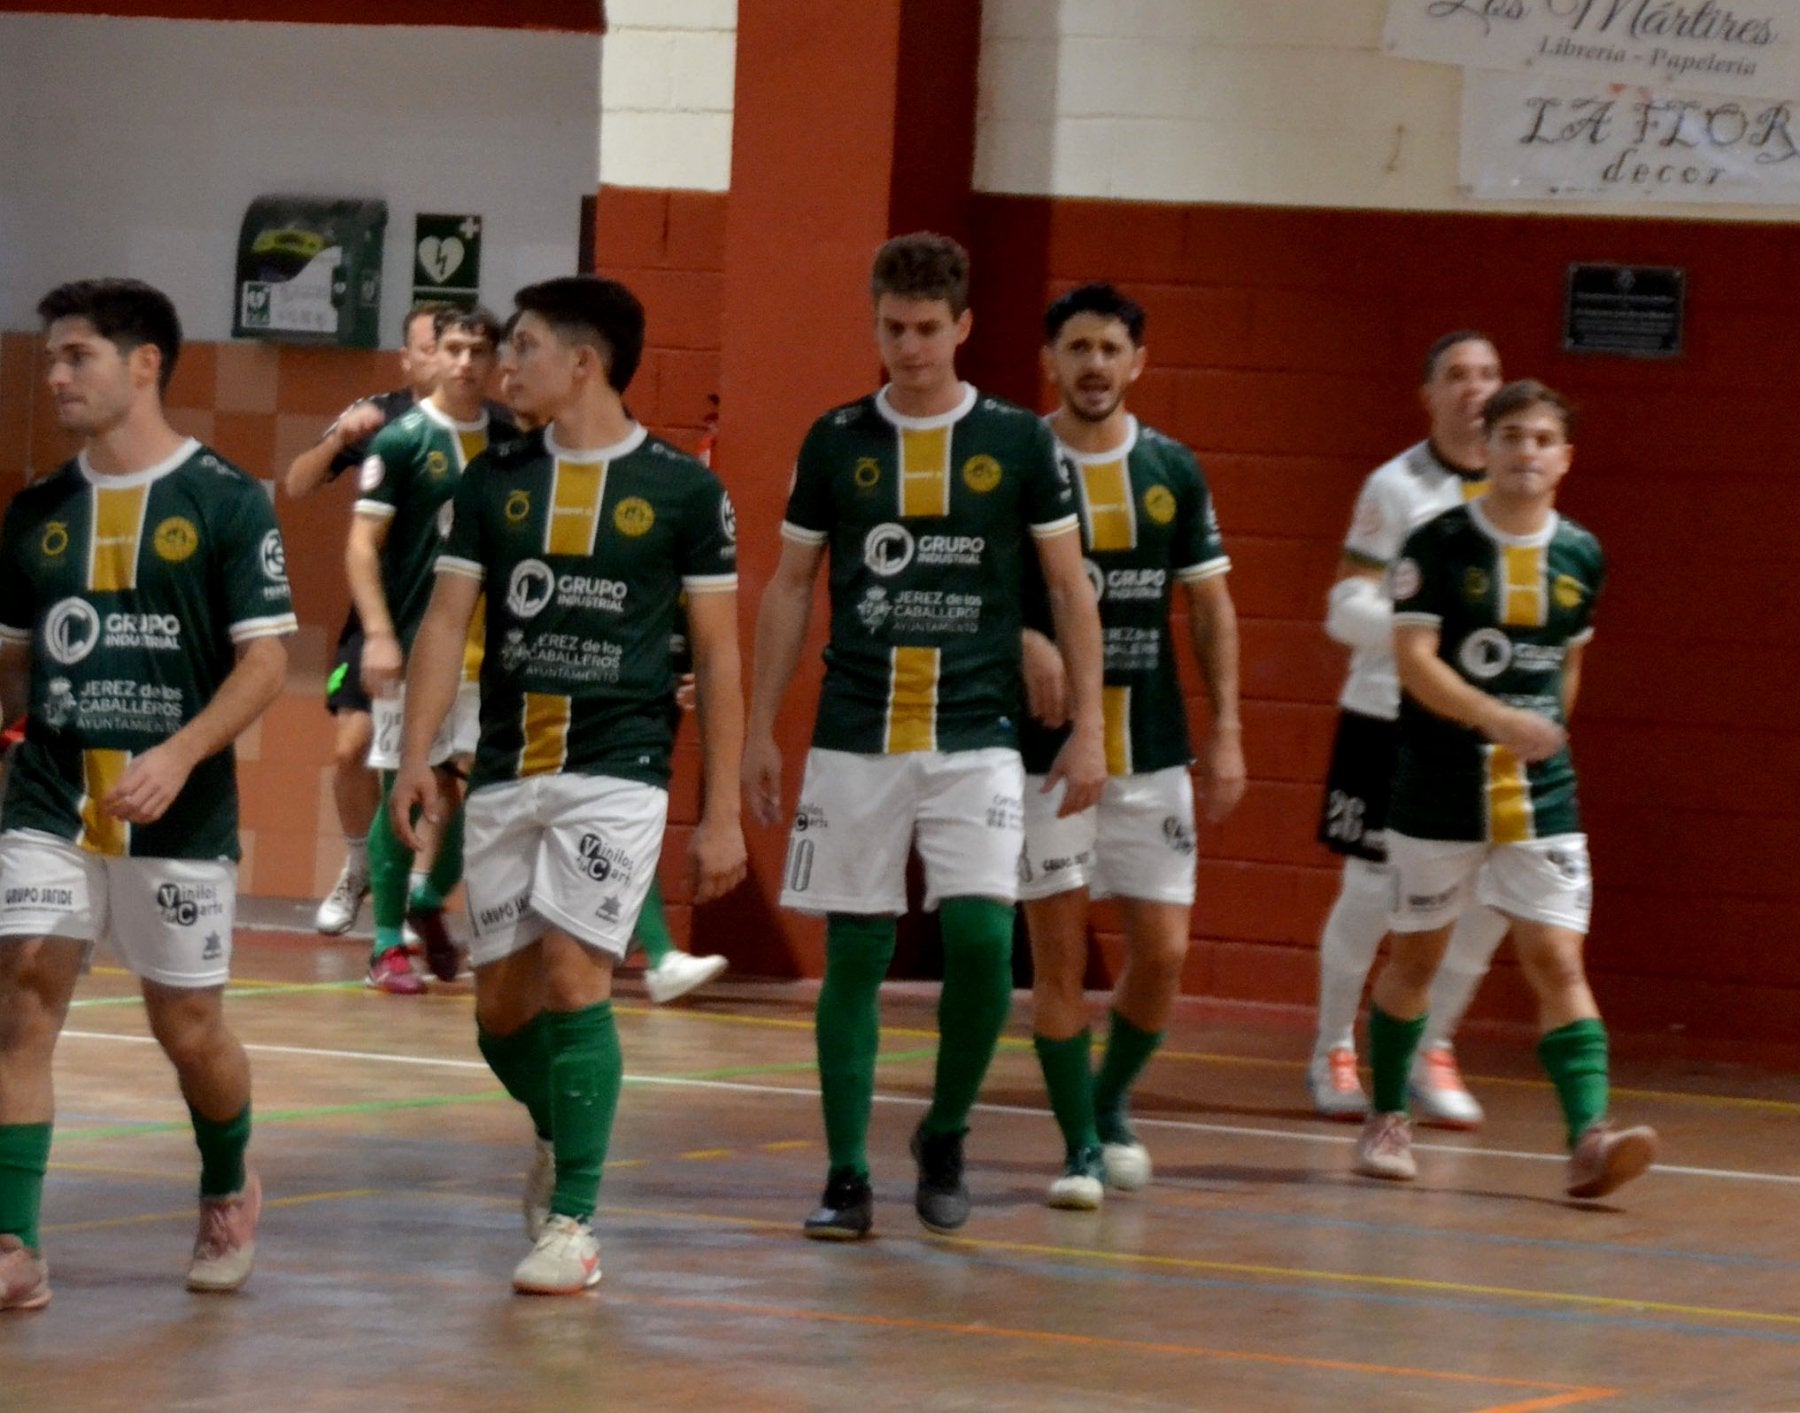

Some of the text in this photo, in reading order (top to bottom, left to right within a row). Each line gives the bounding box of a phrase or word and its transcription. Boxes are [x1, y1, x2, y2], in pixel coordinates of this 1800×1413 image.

[1520, 98, 1800, 164] LA FLOR
[1602, 149, 1727, 185] decor
[918, 535, 985, 553] GRUPO
[557, 574, 628, 600] GRUPO
[105, 613, 181, 636] GRUPO
[582, 638, 600, 653] de
[602, 641, 622, 656] los
[81, 680, 137, 698] JEREZ
[79, 698, 183, 717] CABALLEROS
[5, 887, 39, 905] GRUPO
